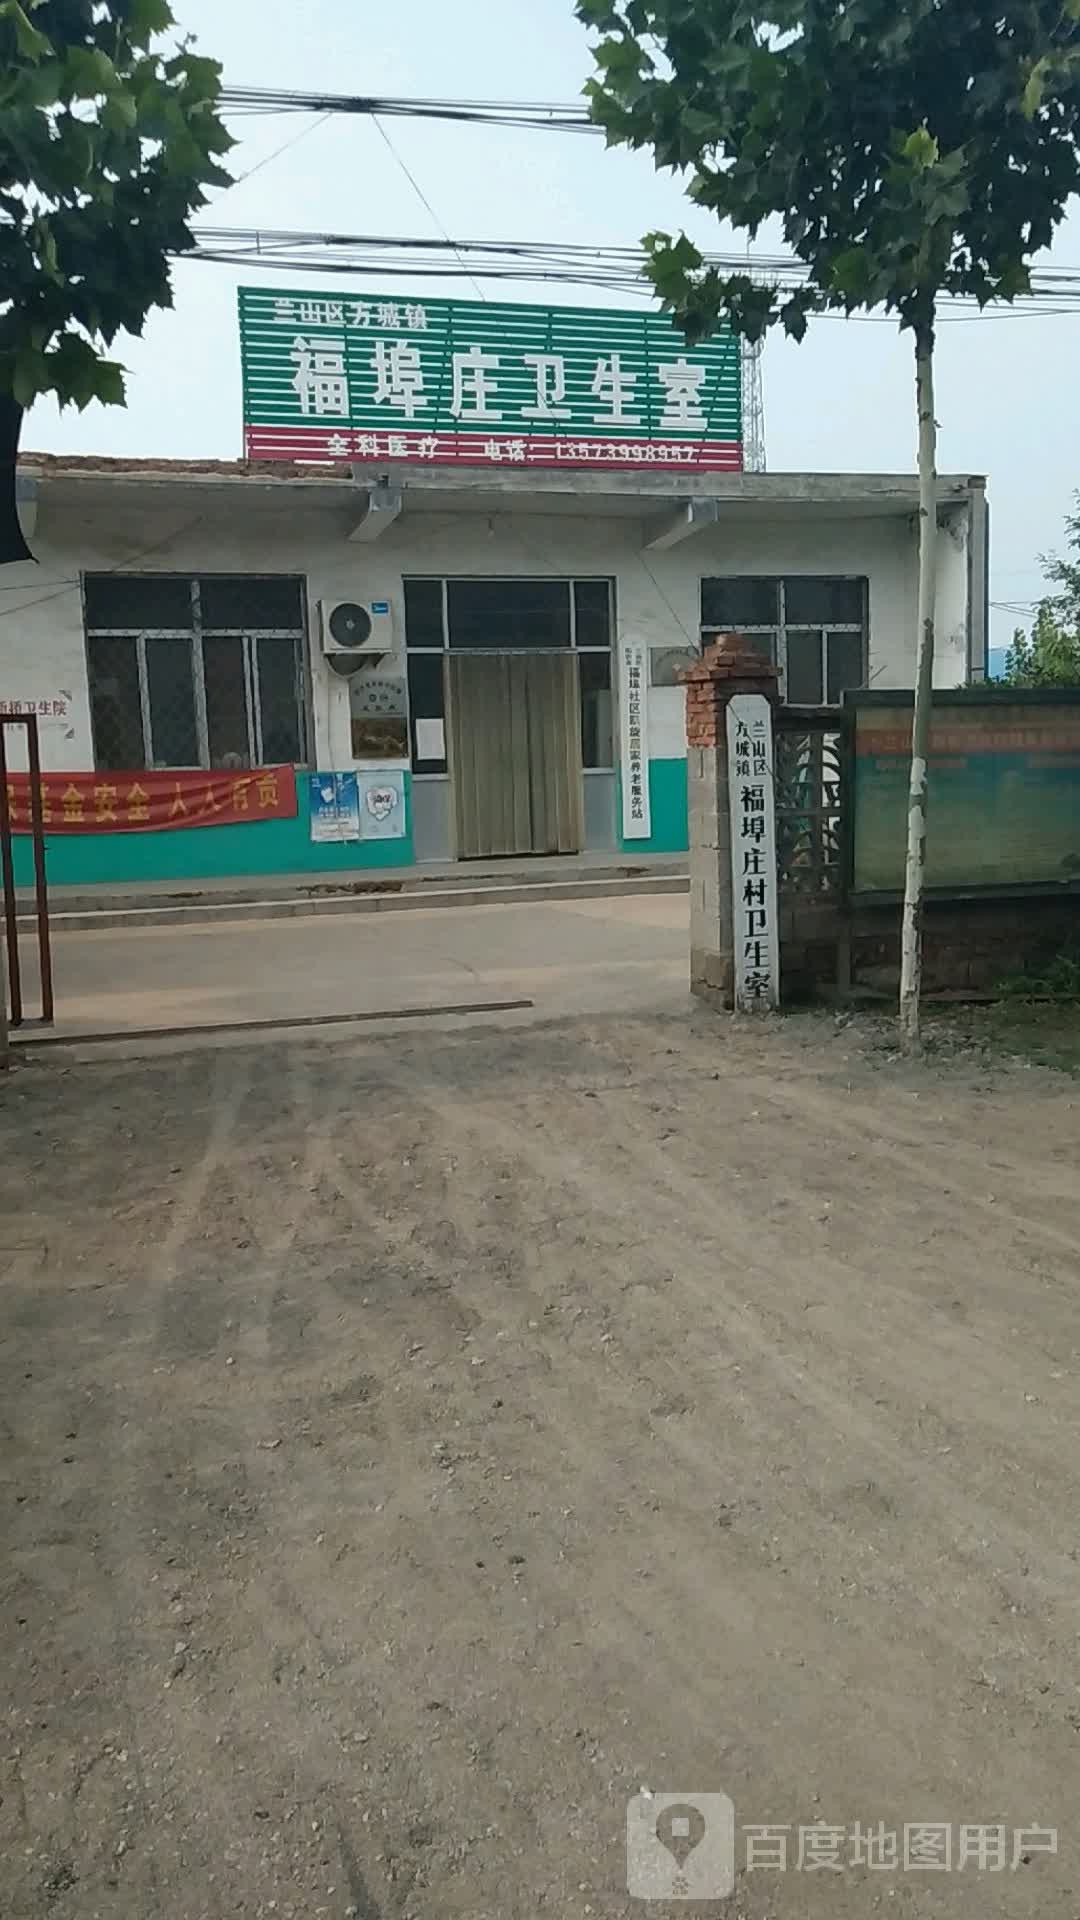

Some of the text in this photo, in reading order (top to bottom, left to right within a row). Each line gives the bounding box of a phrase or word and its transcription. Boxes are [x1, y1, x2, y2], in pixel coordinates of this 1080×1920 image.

[274, 297, 428, 330] 兰山区方城镇
[290, 336, 709, 429] 福埠庄卫生室
[327, 433, 439, 459] 全科医疗
[735, 719, 751, 777] 方城镇
[752, 719, 767, 777] 兰山区
[167, 771, 280, 817] 人人有责
[740, 784, 771, 1000] 福埠庄村卫生室
